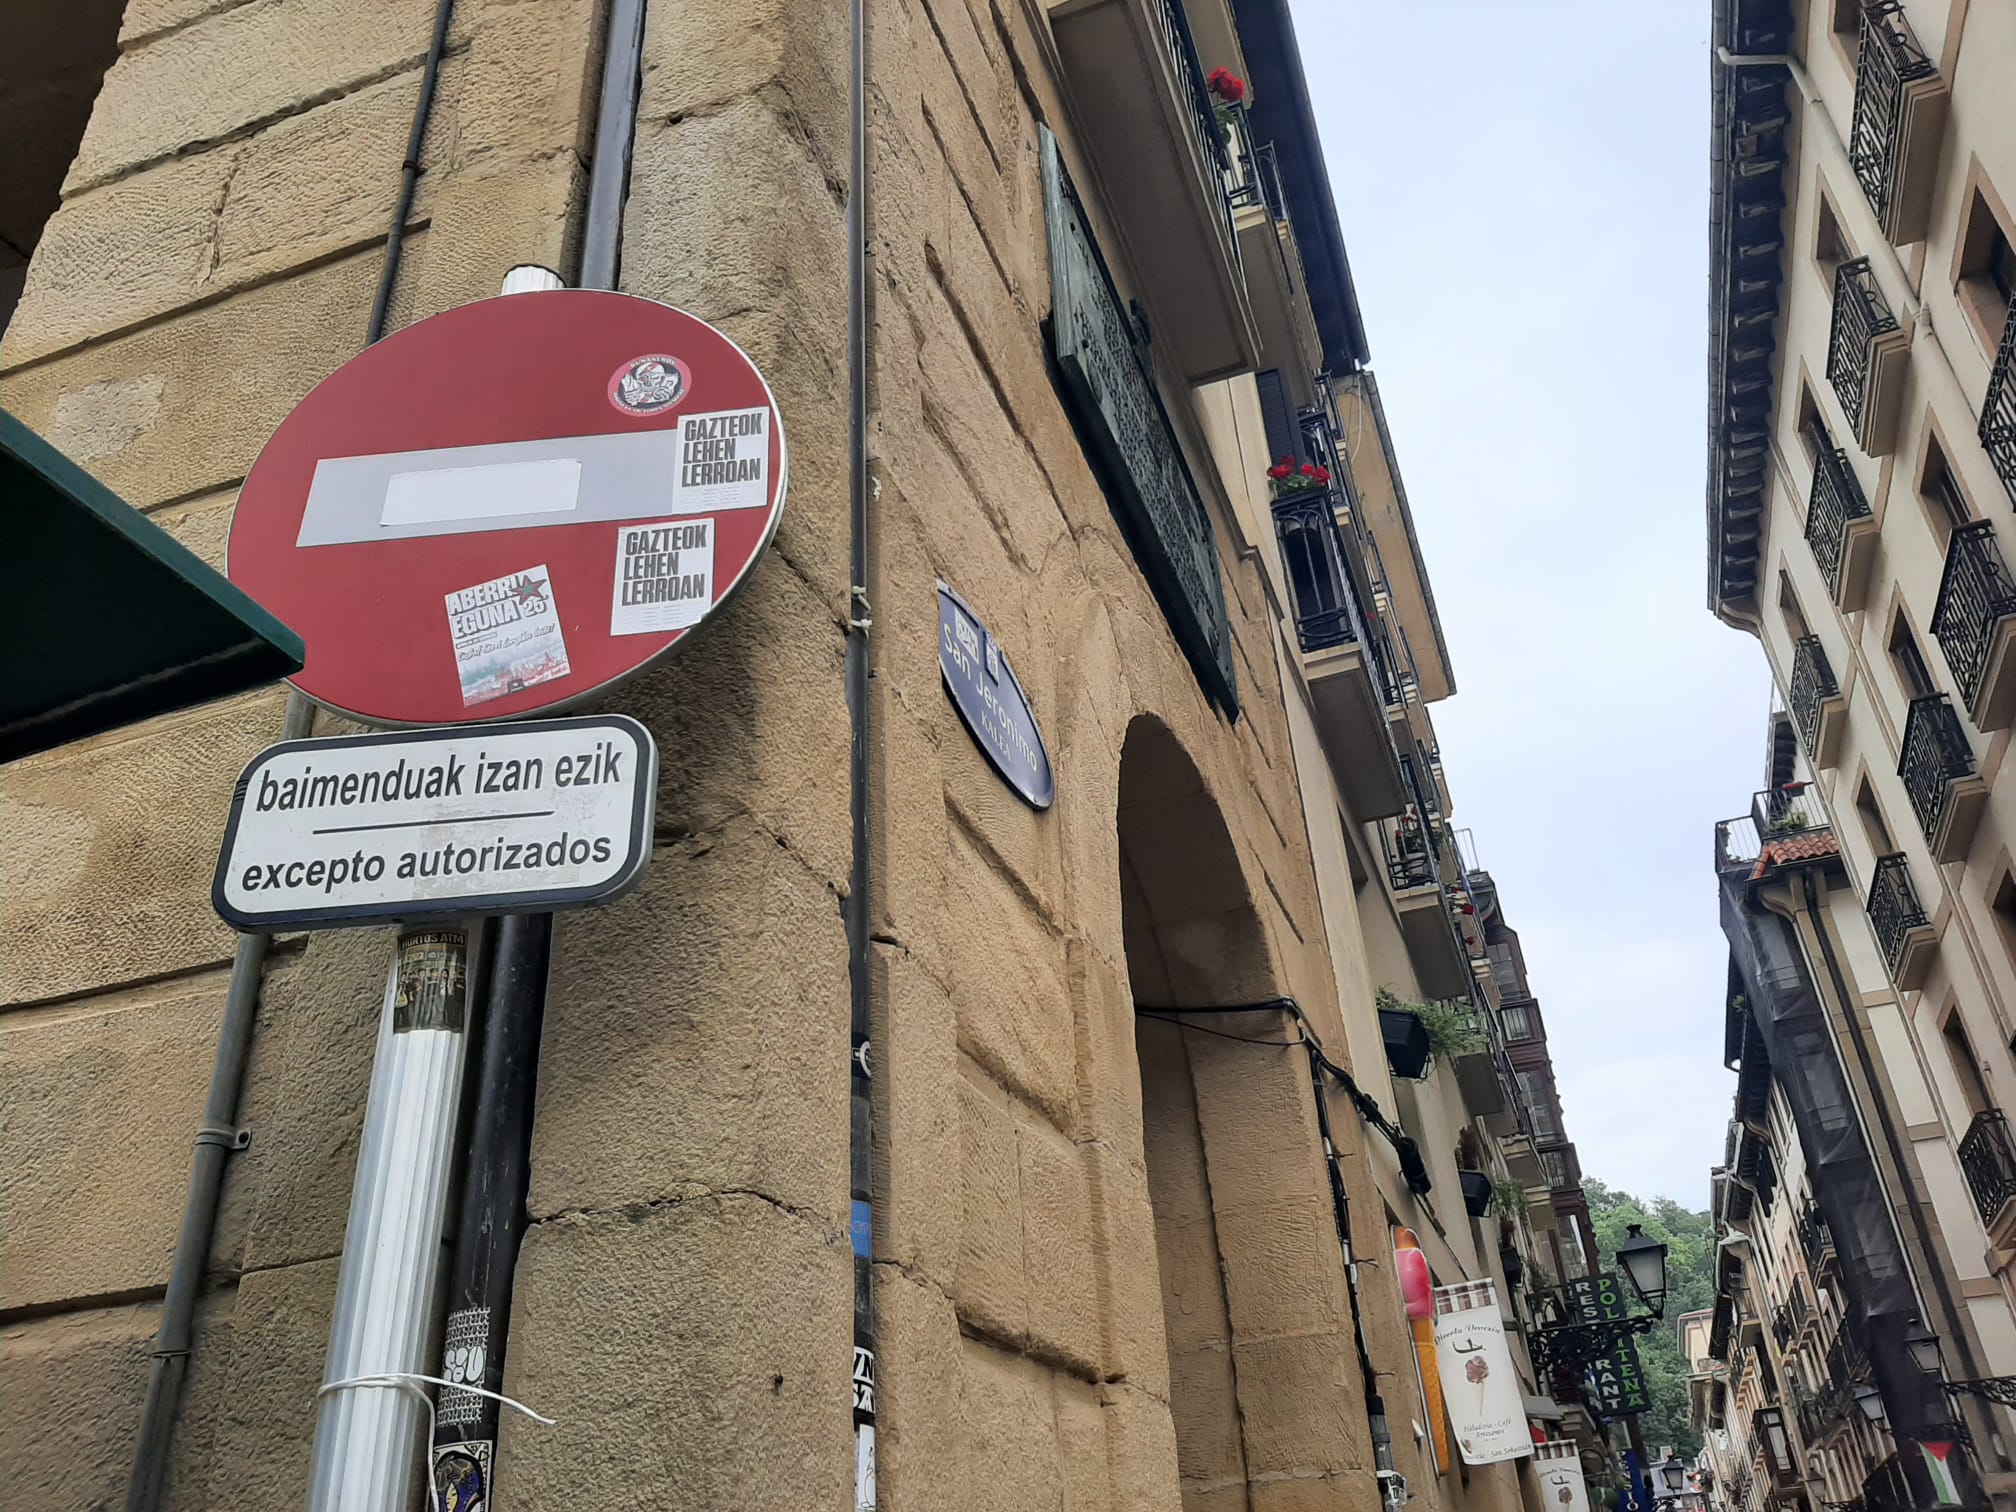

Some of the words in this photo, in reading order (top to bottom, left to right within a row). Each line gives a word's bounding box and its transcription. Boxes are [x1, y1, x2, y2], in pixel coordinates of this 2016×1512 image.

[684, 412, 762, 441] GAZTEOK
[683, 438, 736, 465] LEHEN
[682, 457, 761, 487] LERROAN
[625, 524, 708, 556] GAZTEOK
[623, 551, 680, 580] LEHEN
[448, 574, 522, 616] ABERRI
[621, 573, 705, 607] LERROAN
[451, 600, 521, 639] EGUNA
[943, 623, 971, 681] San
[976, 671, 1037, 772] Jeronimo
[981, 710, 1011, 761] KALEA
[255, 753, 467, 812] baimenduak
[474, 751, 543, 795] izan
[554, 741, 624, 788] ezik
[242, 849, 386, 894] excepto
[397, 831, 612, 878] autorizados
